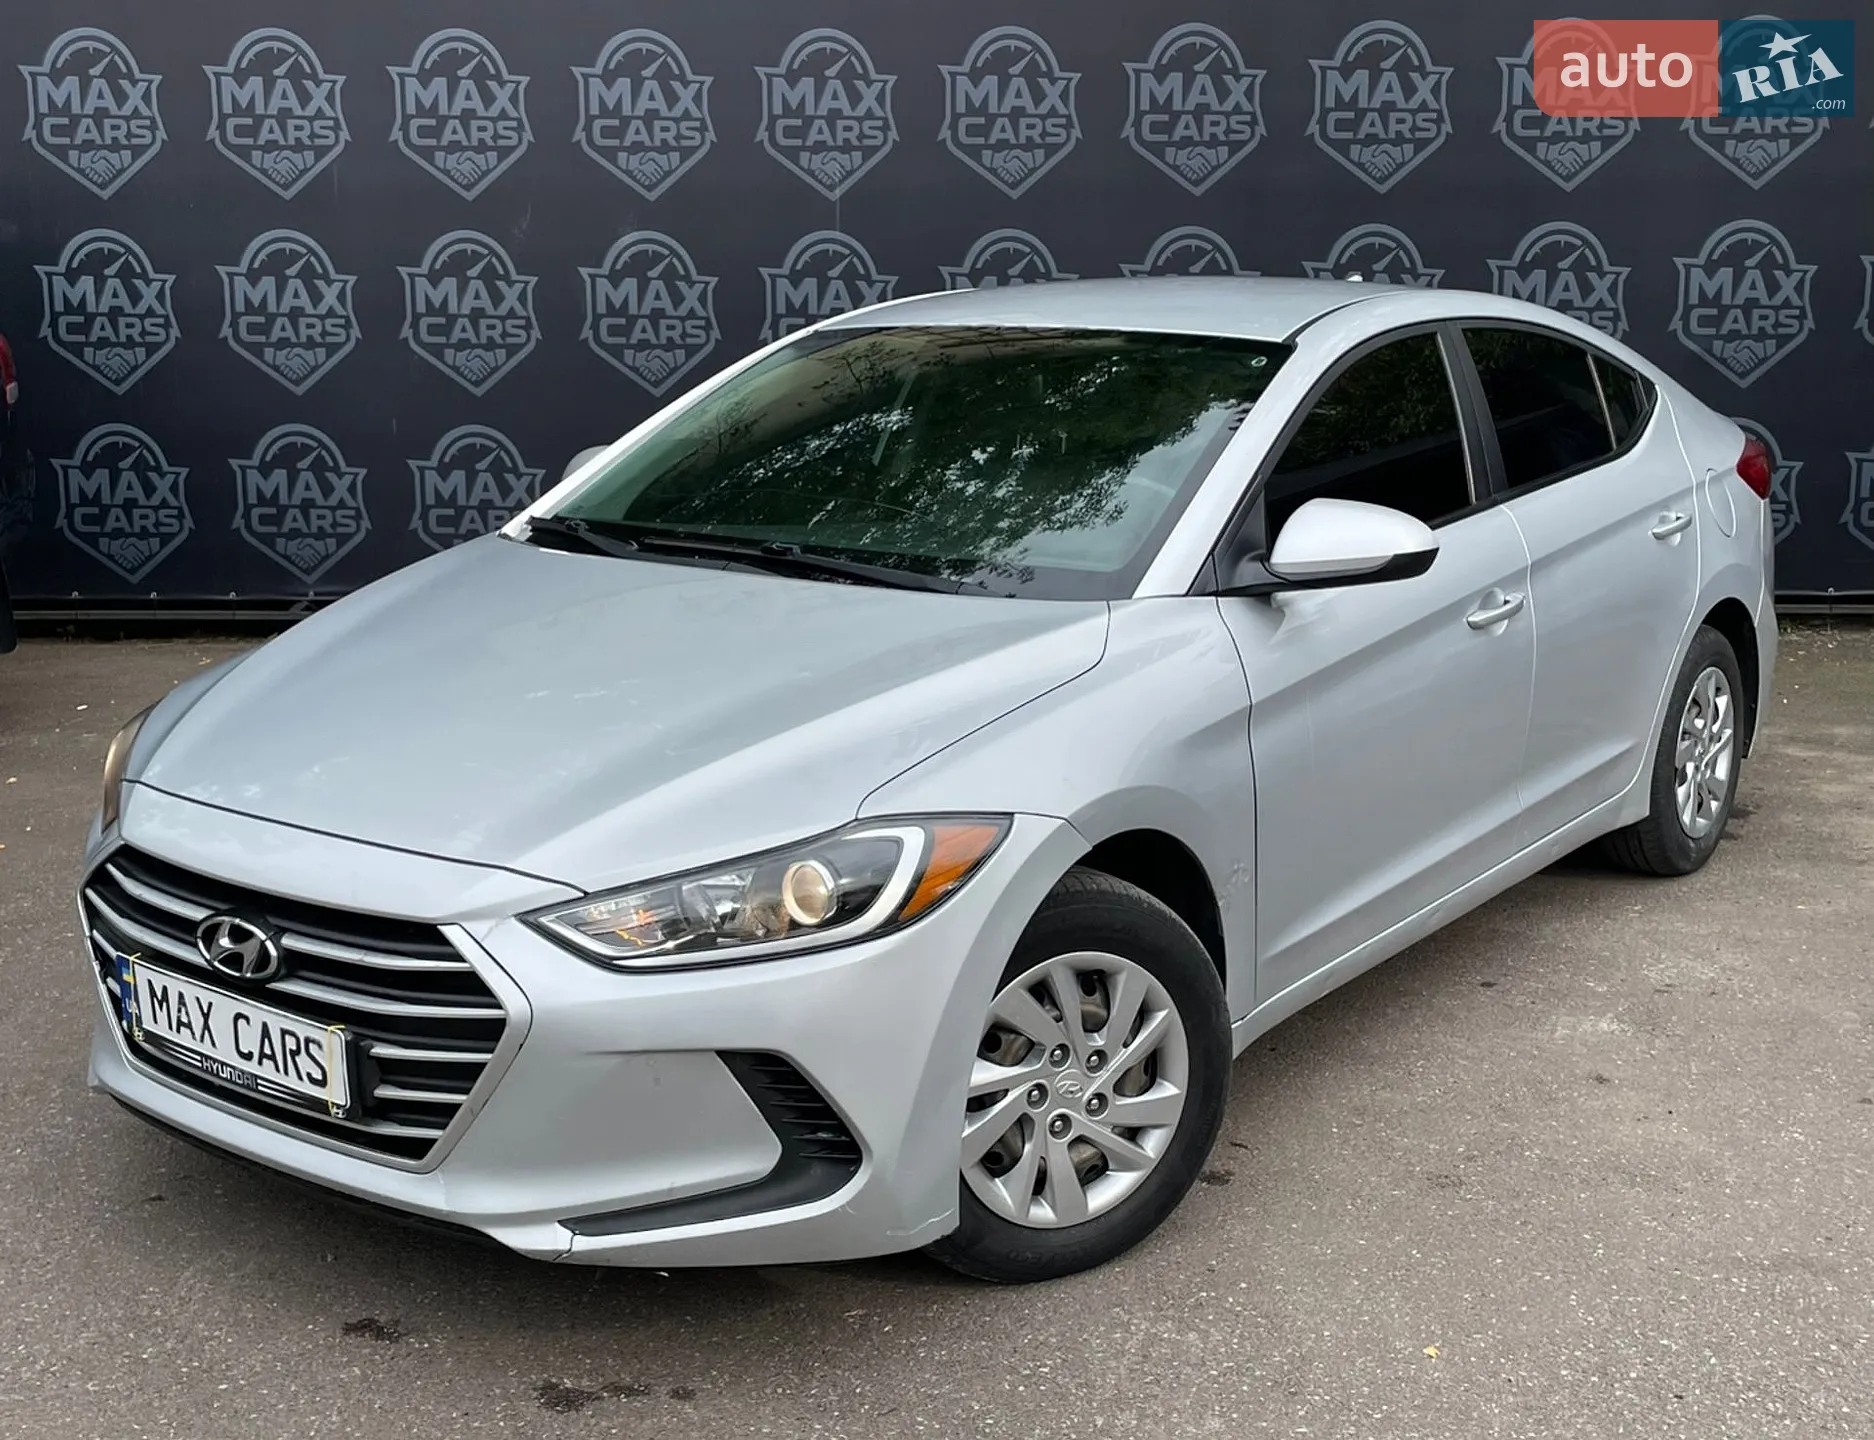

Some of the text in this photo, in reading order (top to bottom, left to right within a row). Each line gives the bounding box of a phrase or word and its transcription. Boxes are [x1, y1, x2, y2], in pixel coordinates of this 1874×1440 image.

[37, 76, 152, 116] MAX
[220, 76, 335, 117] MAX
[404, 77, 519, 117] MAX
[588, 77, 702, 118] MAX
[772, 77, 885, 117] MAX
[956, 75, 1069, 115] MAX
[1140, 72, 1256, 112] MAX
[1325, 70, 1440, 110] MAX
[43, 117, 153, 145] CARS
[226, 118, 336, 146] CARS
[409, 118, 519, 146] CARS
[592, 119, 701, 147] CARS
[776, 119, 884, 146] CARS
[958, 117, 1067, 145] CARS
[1142, 114, 1252, 142] CARS
[1326, 111, 1437, 139] CARS
[1513, 109, 1625, 137] CARS
[52, 276, 164, 316] MAX
[234, 276, 345, 316] MAX
[415, 277, 526, 317] MAX
[597, 277, 707, 318] MAX
[1503, 269, 1619, 308] MAX
[1688, 267, 1803, 306] MAX
[58, 316, 167, 343] CARS
[237, 316, 347, 343] CARS
[419, 317, 528, 344] CARS
[599, 318, 707, 345] CARS
[1690, 308, 1800, 335] CARS
[70, 466, 182, 505] MAX
[247, 466, 359, 506] MAX
[424, 469, 533, 507] MAX
[74, 507, 181, 534] CARS
[251, 507, 357, 534] CARS
[429, 508, 519, 534] CAR
[148, 978, 329, 1089] MAX CARS
